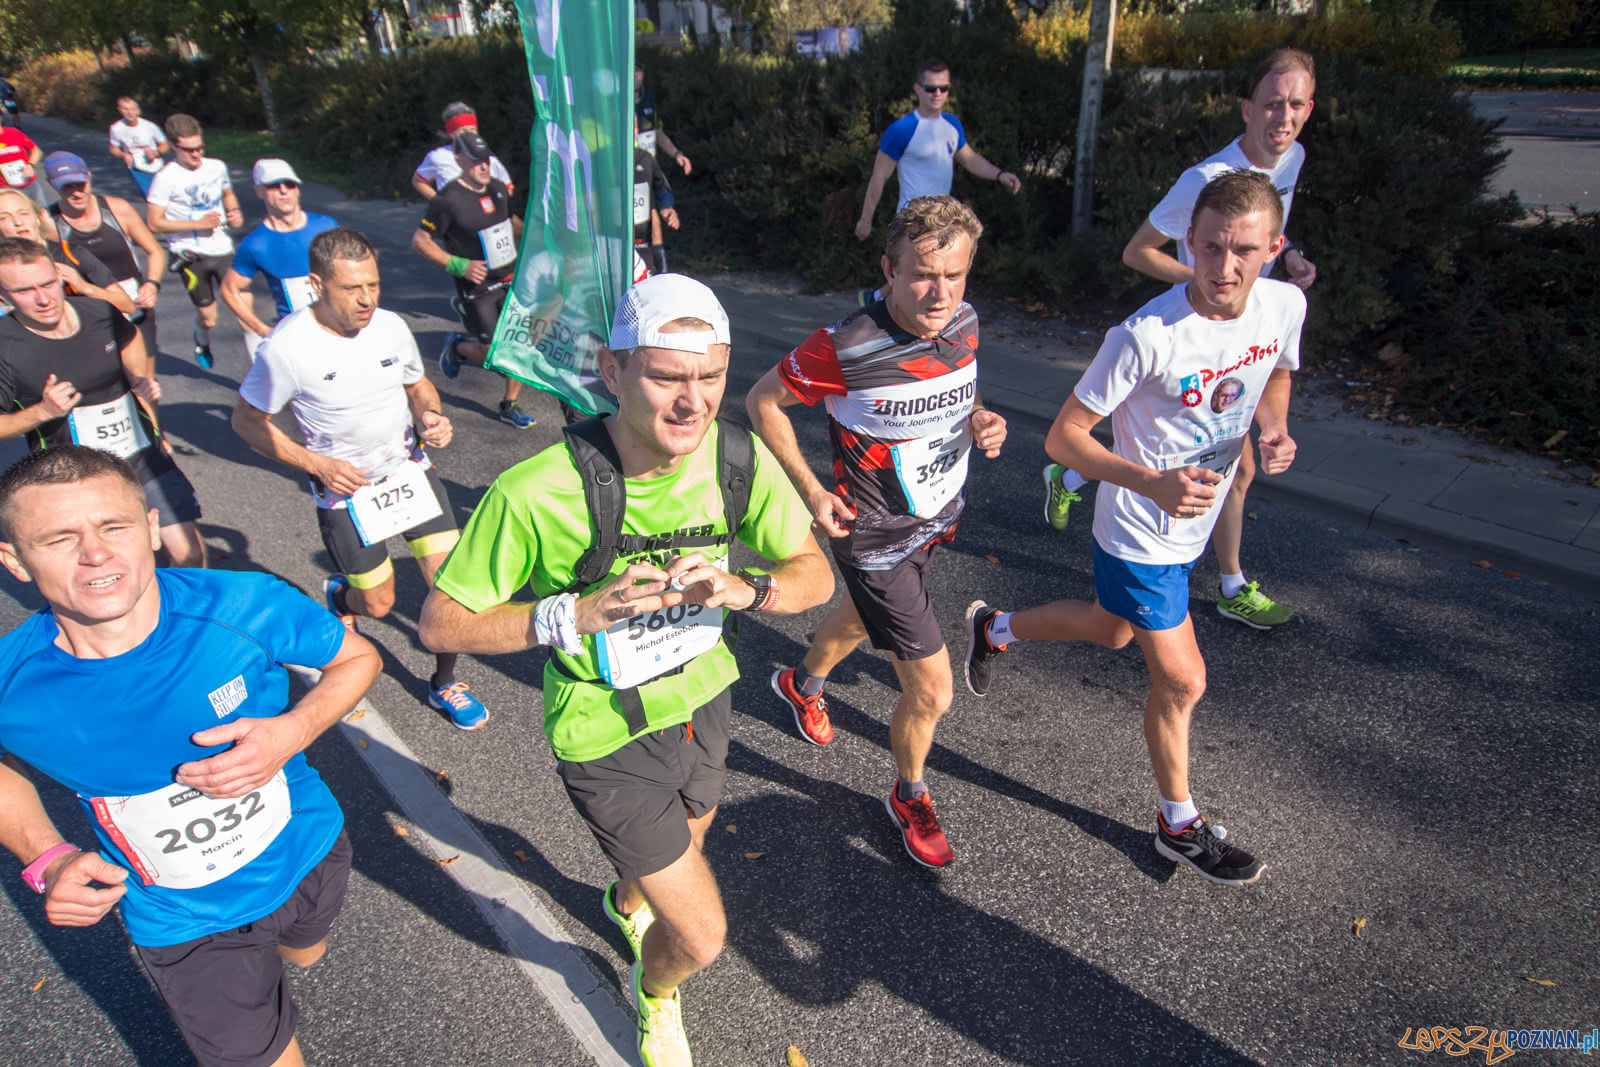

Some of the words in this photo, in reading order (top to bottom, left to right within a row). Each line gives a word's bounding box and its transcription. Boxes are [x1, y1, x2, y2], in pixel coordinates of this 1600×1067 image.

[96, 416, 132, 439] 5312
[883, 419, 905, 428] Your
[908, 414, 943, 427] Journey,
[945, 408, 960, 418] Our
[916, 448, 959, 484] 3973
[371, 484, 414, 511] 1275
[665, 622, 699, 641] Esteban
[210, 684, 231, 706] KEEP
[232, 677, 243, 692] ON
[155, 791, 266, 855] 2032
[201, 834, 243, 857] Marcin
